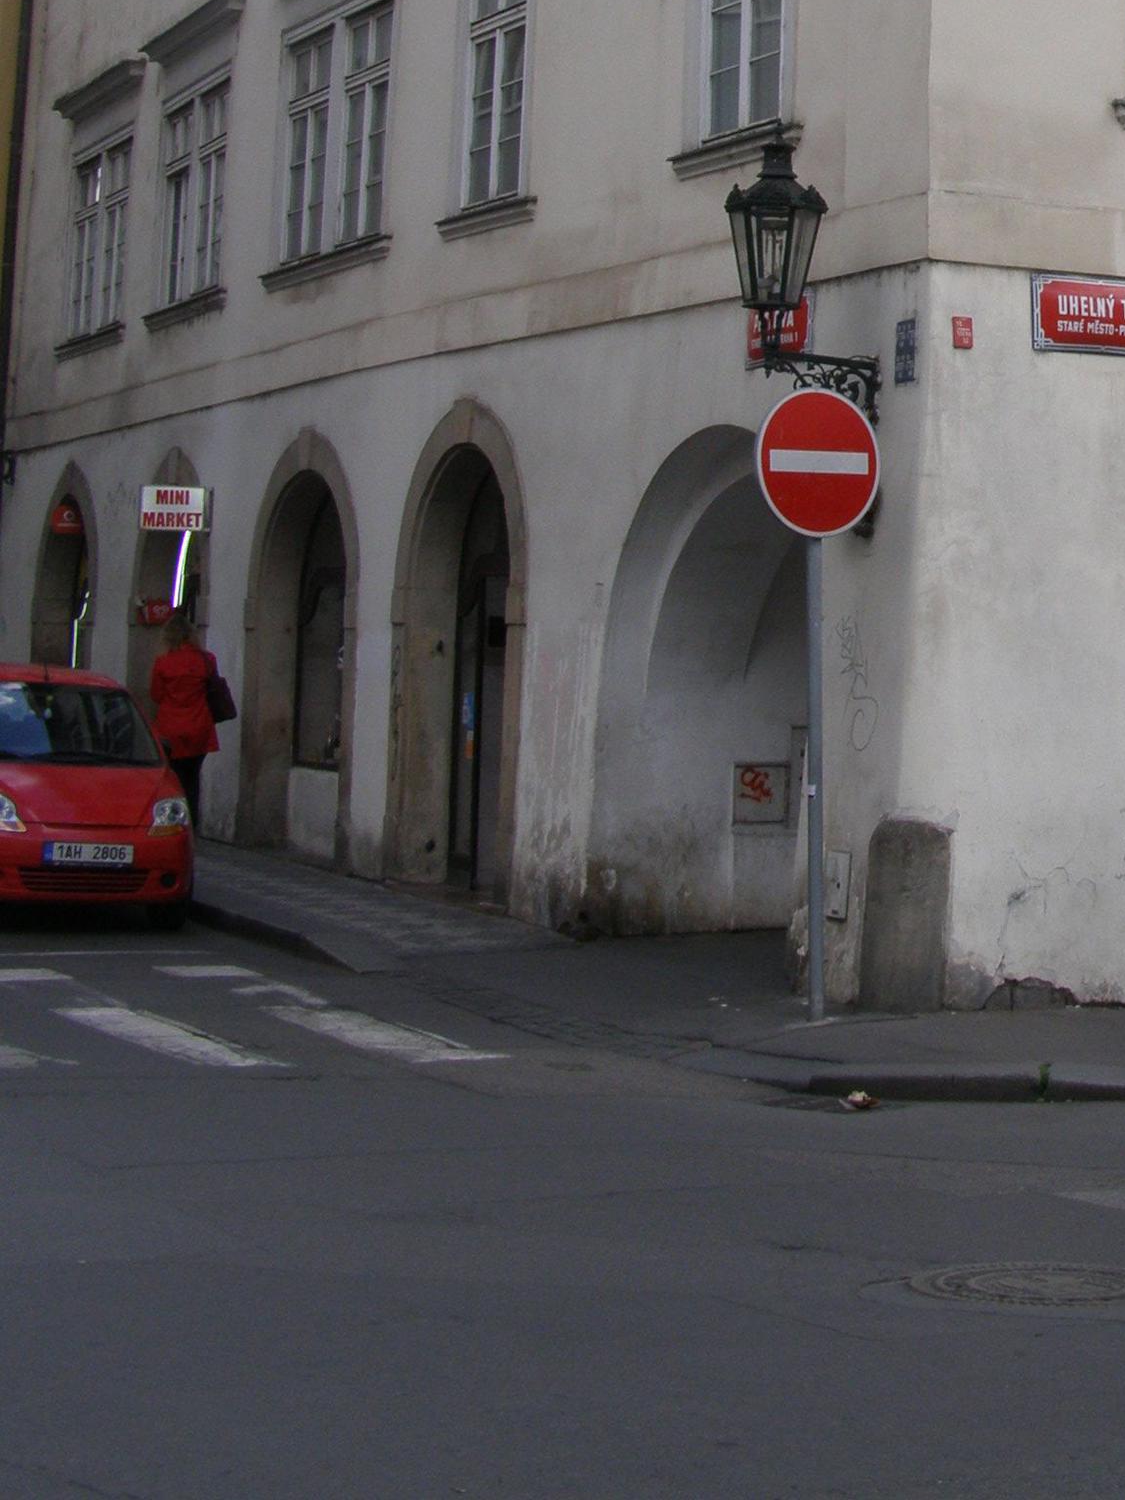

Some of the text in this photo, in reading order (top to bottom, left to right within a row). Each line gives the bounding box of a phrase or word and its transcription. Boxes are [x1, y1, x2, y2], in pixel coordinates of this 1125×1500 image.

[1057, 294, 1114, 319] UHELNÝ
[1057, 319, 1084, 333] STARÉ
[1087, 320, 1114, 334] MĚSTO
[156, 489, 190, 505] MINI
[143, 512, 202, 528] MARKET
[58, 844, 127, 860] 1AH 2806
